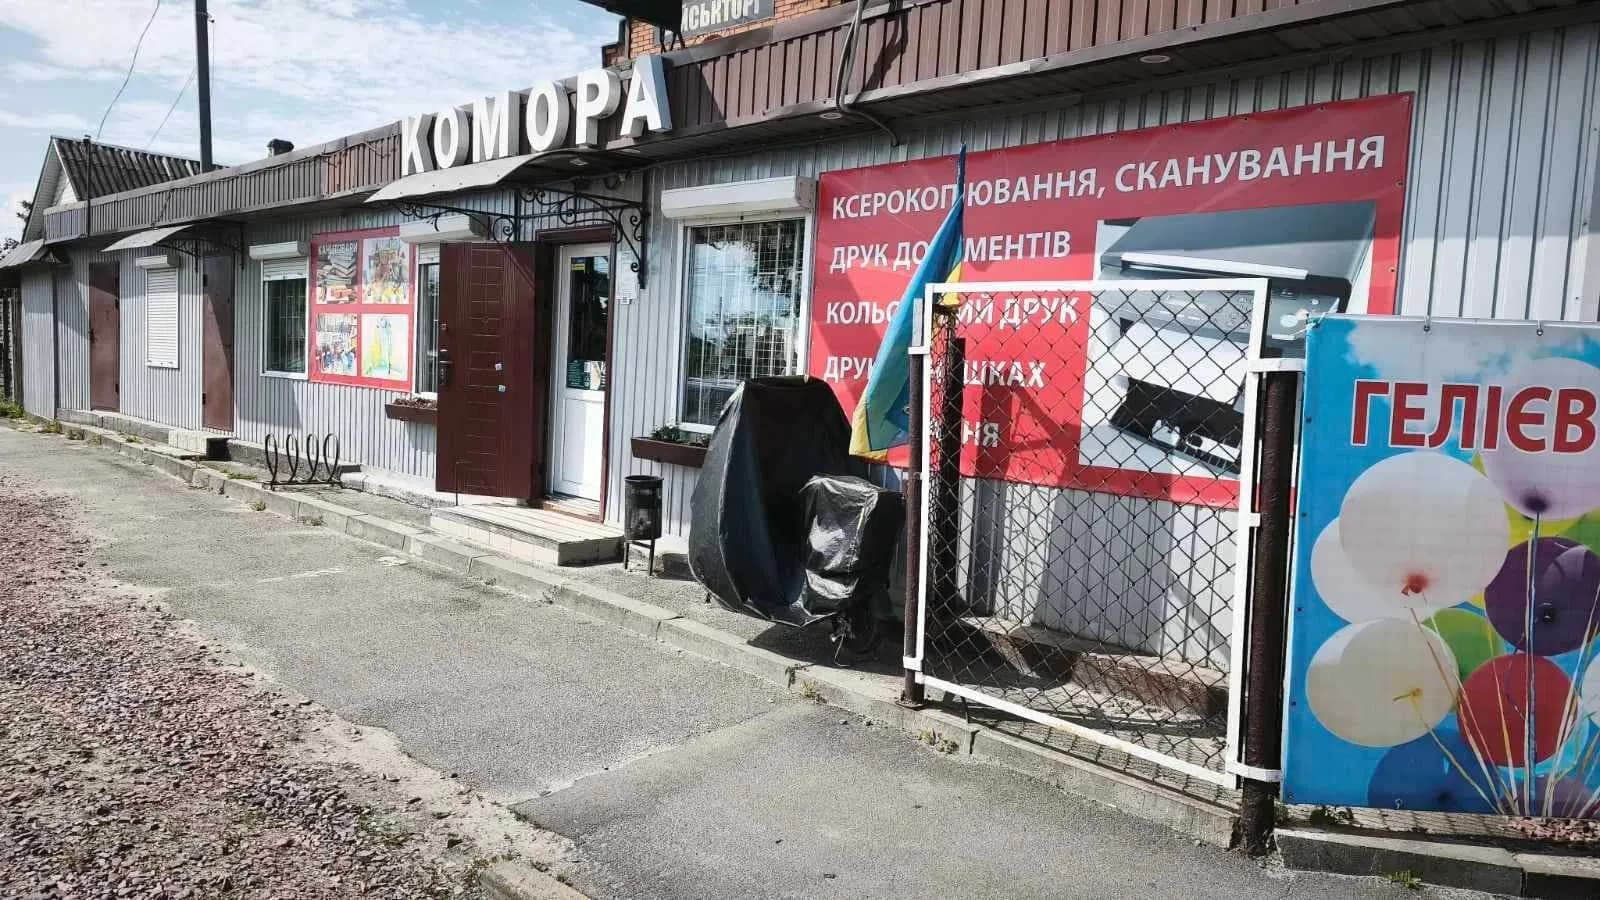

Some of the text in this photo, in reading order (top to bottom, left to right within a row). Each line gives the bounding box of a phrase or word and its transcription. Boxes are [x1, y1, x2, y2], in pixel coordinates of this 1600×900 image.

[402, 54, 672, 175] КОМОРА
[832, 135, 1385, 219] КСЕРОКОПЮВАННЯ, СКАНУВАННЯ
[830, 231, 1071, 274] ДРУК ДОМЕНТІВ
[999, 297, 1080, 330] ДРУК
[1351, 379, 1599, 455] ГЕЛІЄВ
